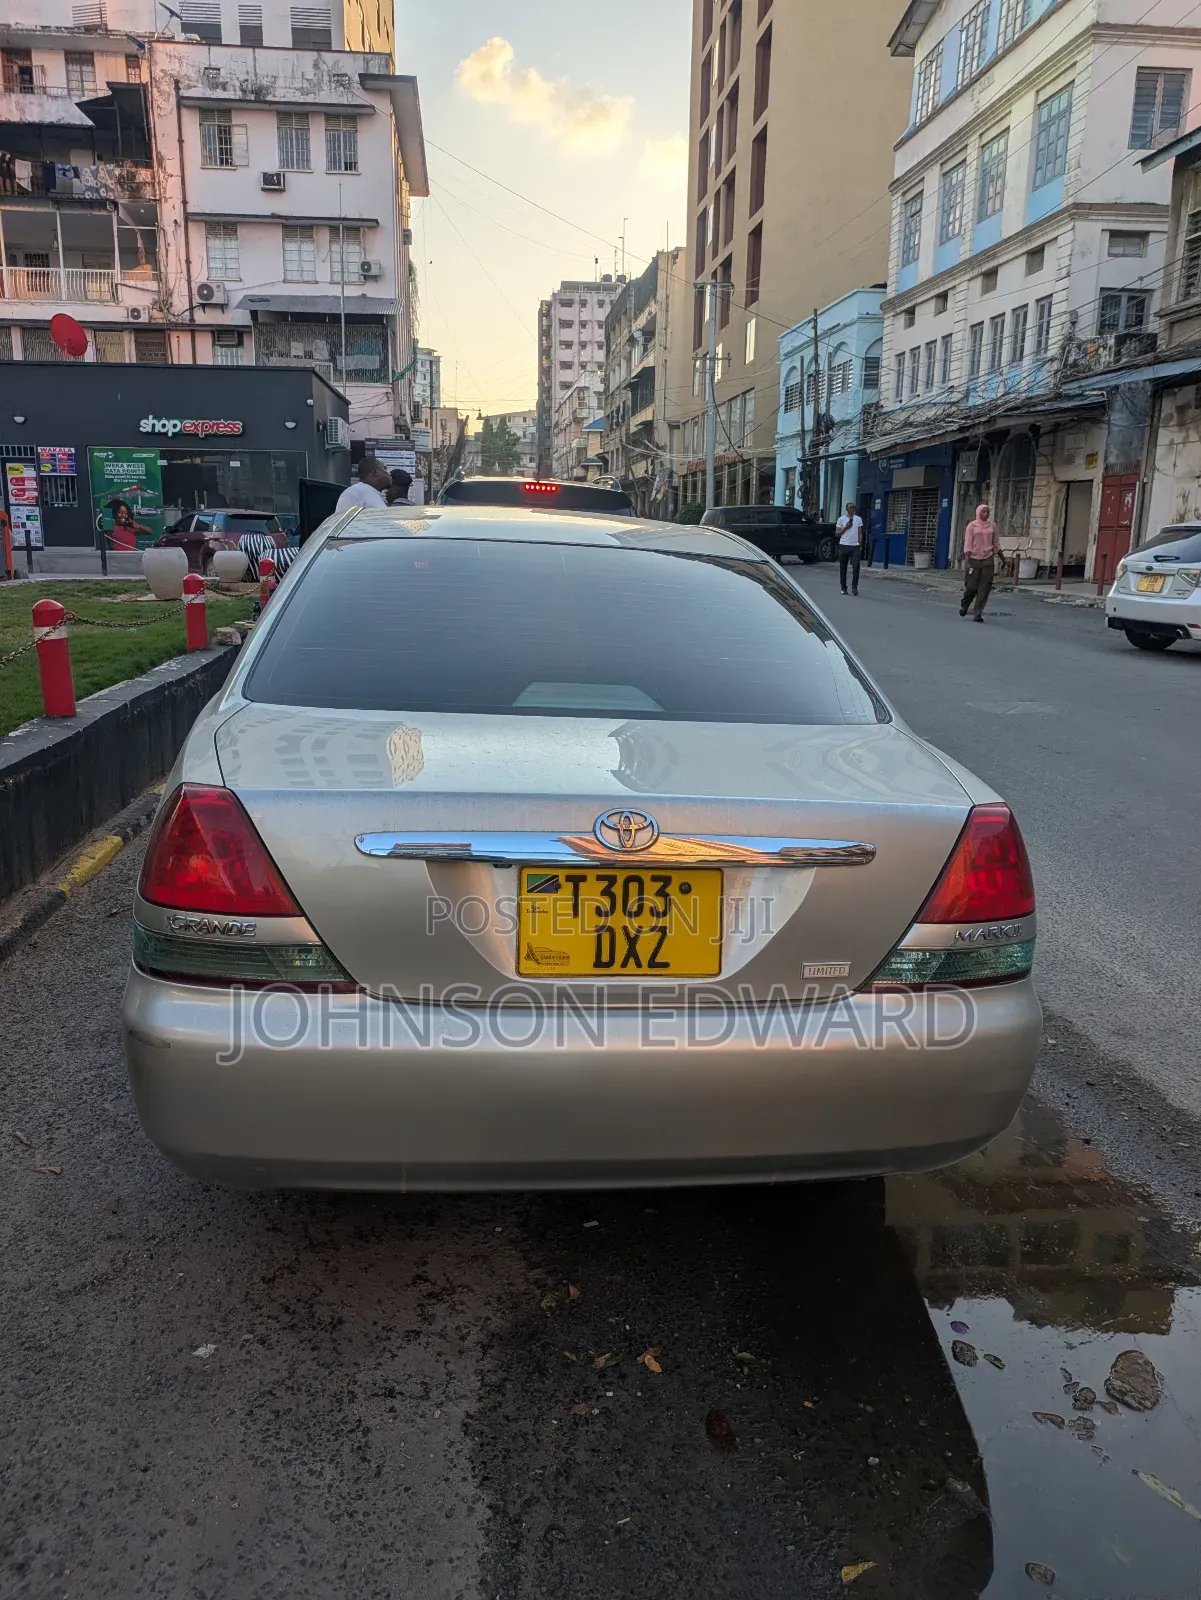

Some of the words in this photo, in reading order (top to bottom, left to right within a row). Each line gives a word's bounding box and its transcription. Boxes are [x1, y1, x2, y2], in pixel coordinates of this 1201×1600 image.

[139, 415, 181, 437] shop
[181, 420, 243, 437] express
[166, 914, 257, 937] GRANDE
[593, 925, 670, 968] DXZ
[808, 966, 846, 976] LIMITED
